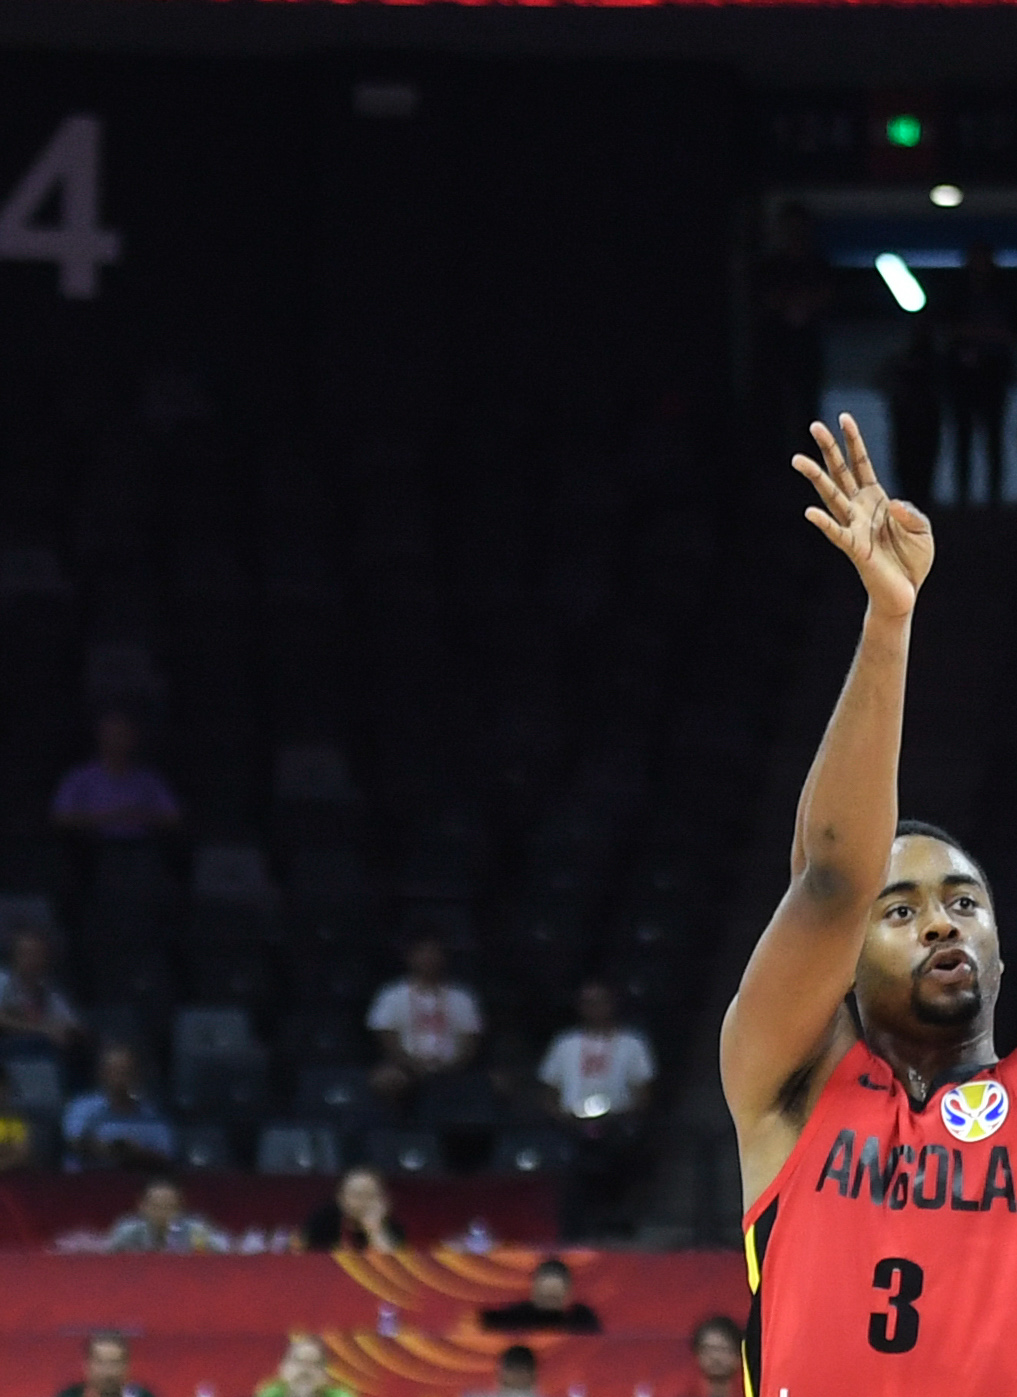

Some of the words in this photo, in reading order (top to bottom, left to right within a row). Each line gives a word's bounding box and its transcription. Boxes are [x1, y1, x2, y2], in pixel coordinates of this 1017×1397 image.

[0, 113, 120, 299] 4
[815, 1127, 1017, 1213] ANGOLA
[867, 1257, 924, 1354] 3
